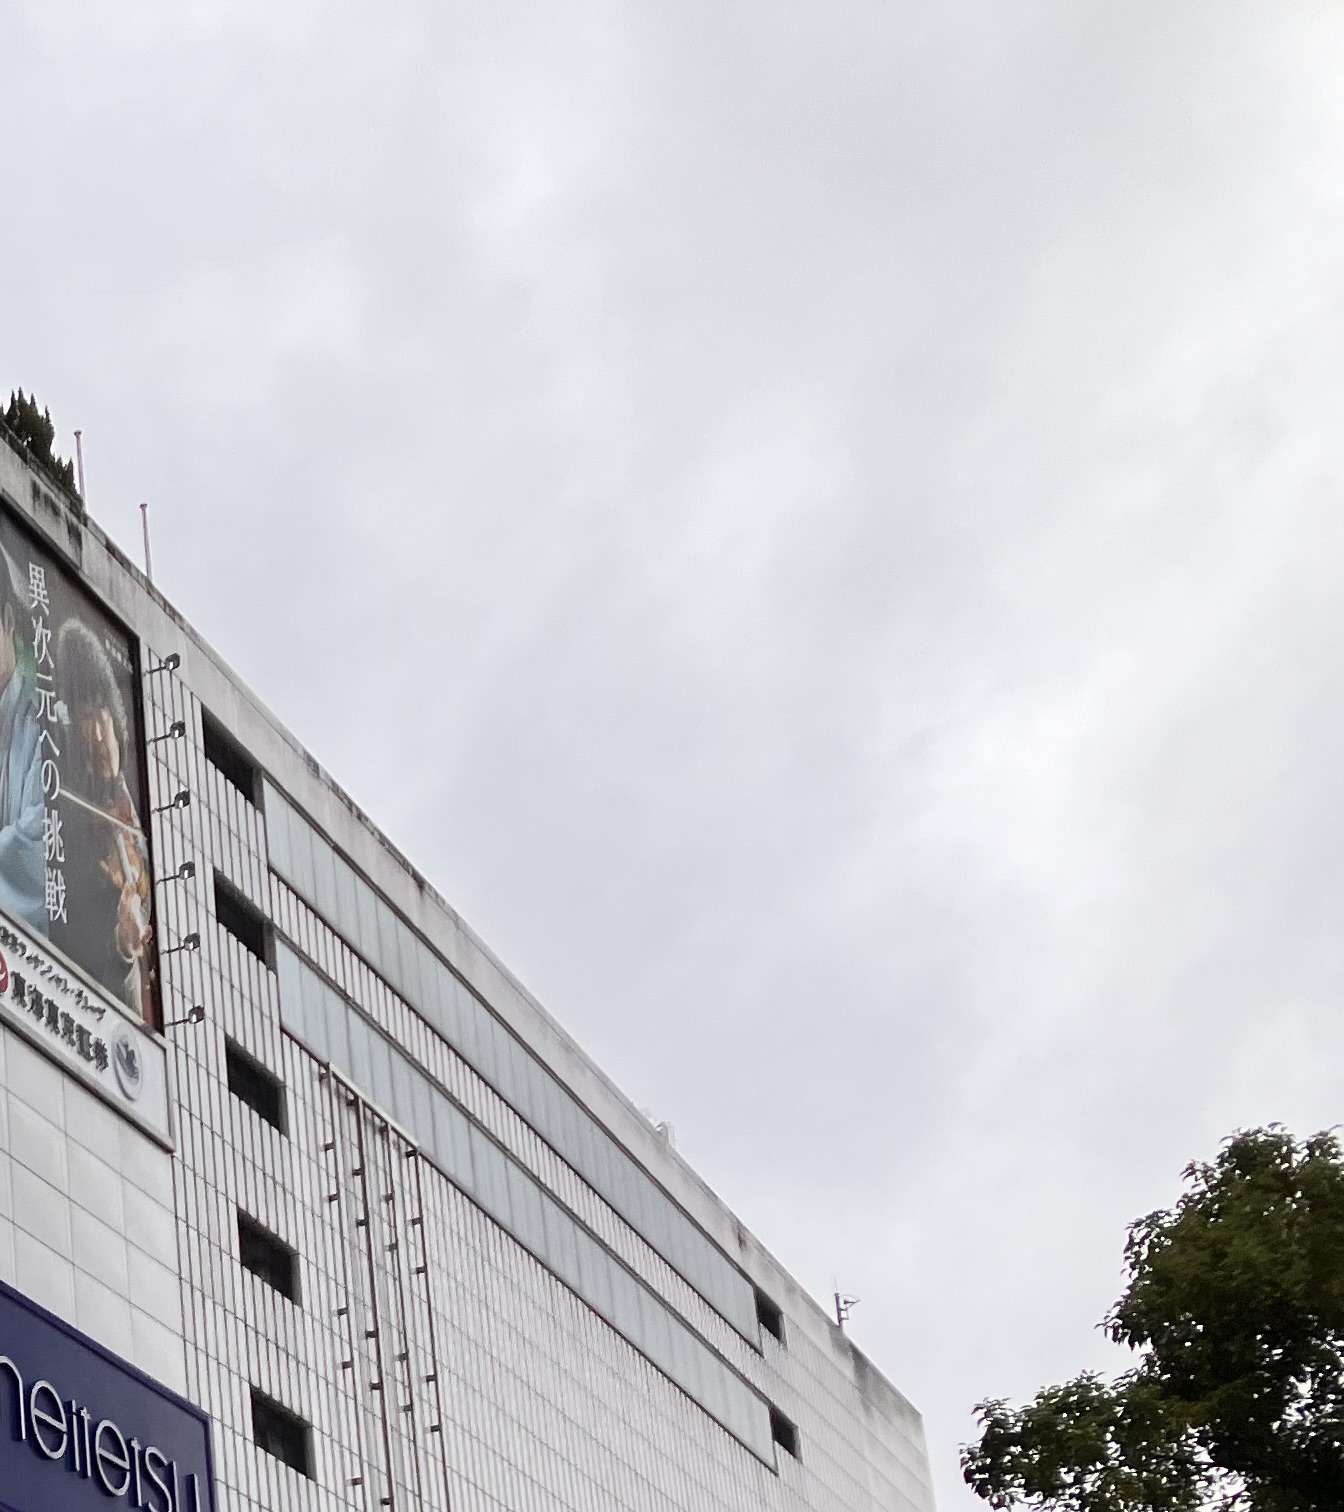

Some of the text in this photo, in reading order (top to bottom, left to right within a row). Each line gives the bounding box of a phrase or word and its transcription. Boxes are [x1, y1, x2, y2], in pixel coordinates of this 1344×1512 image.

[27, 561, 69, 925] 異次元への挑戦
